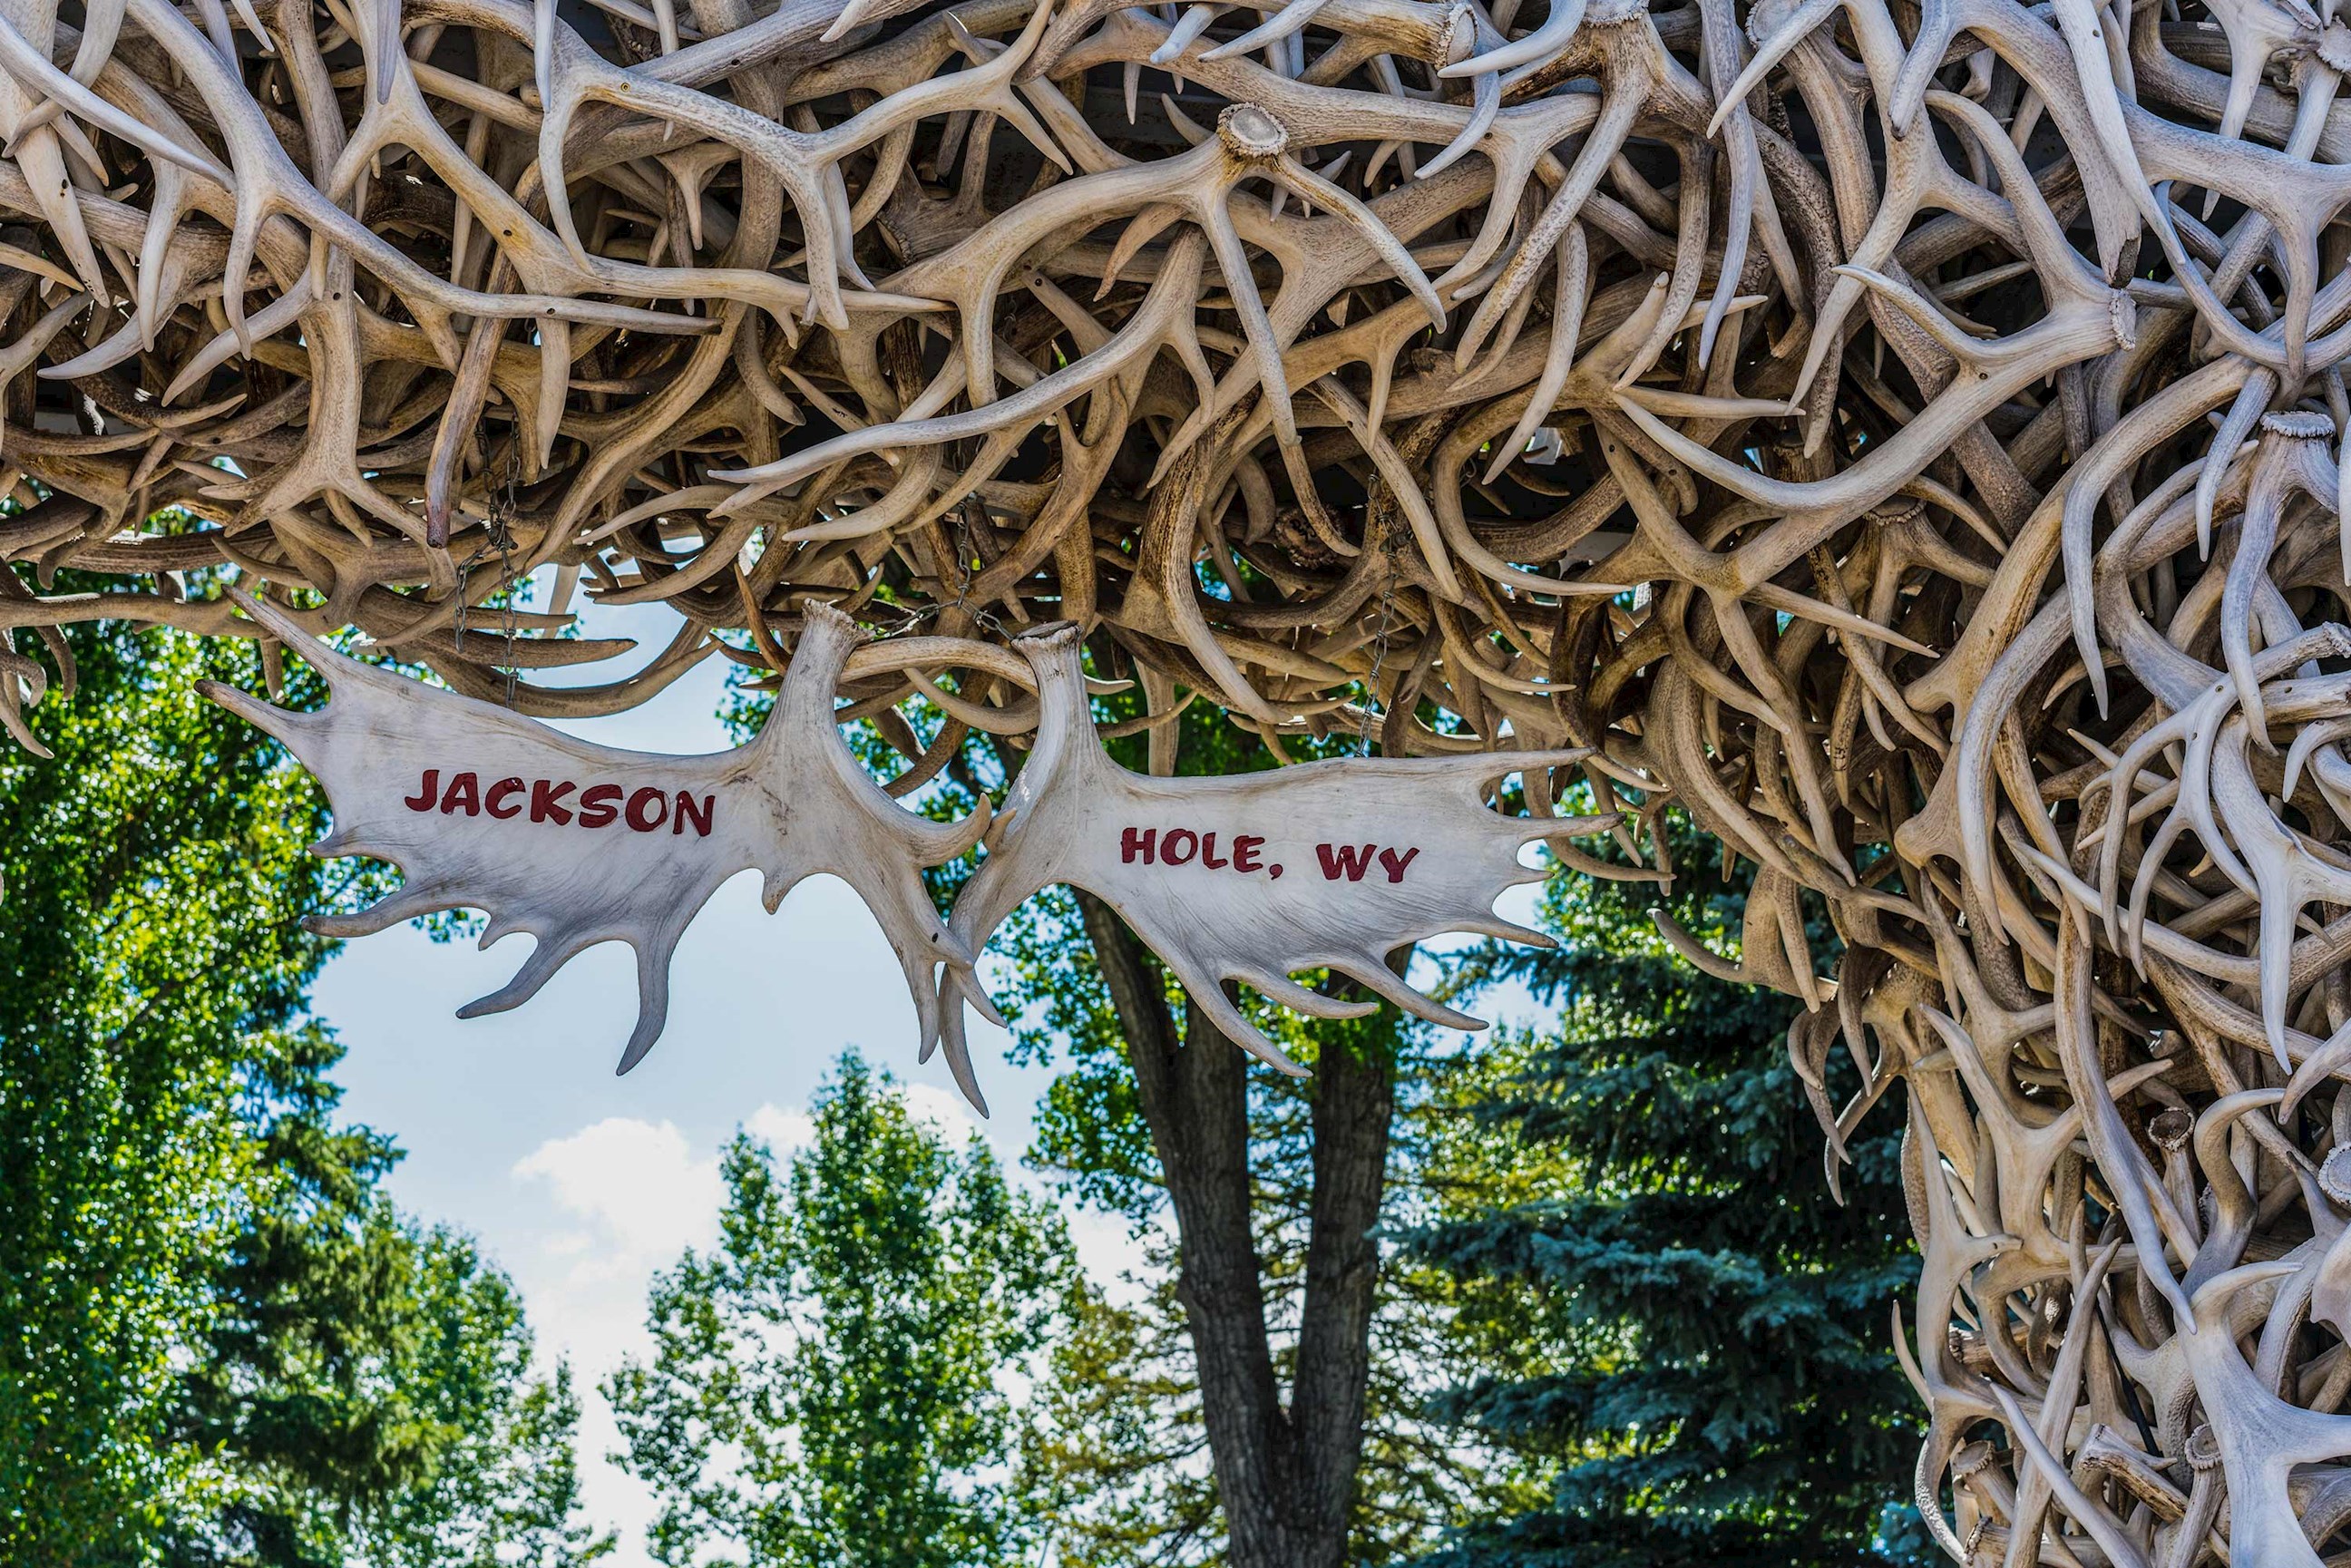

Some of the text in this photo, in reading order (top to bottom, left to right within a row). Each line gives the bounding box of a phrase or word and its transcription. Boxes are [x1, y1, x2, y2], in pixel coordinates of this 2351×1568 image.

[405, 769, 715, 837] JACKSON
[1121, 827, 1420, 883] HOLE, WY
